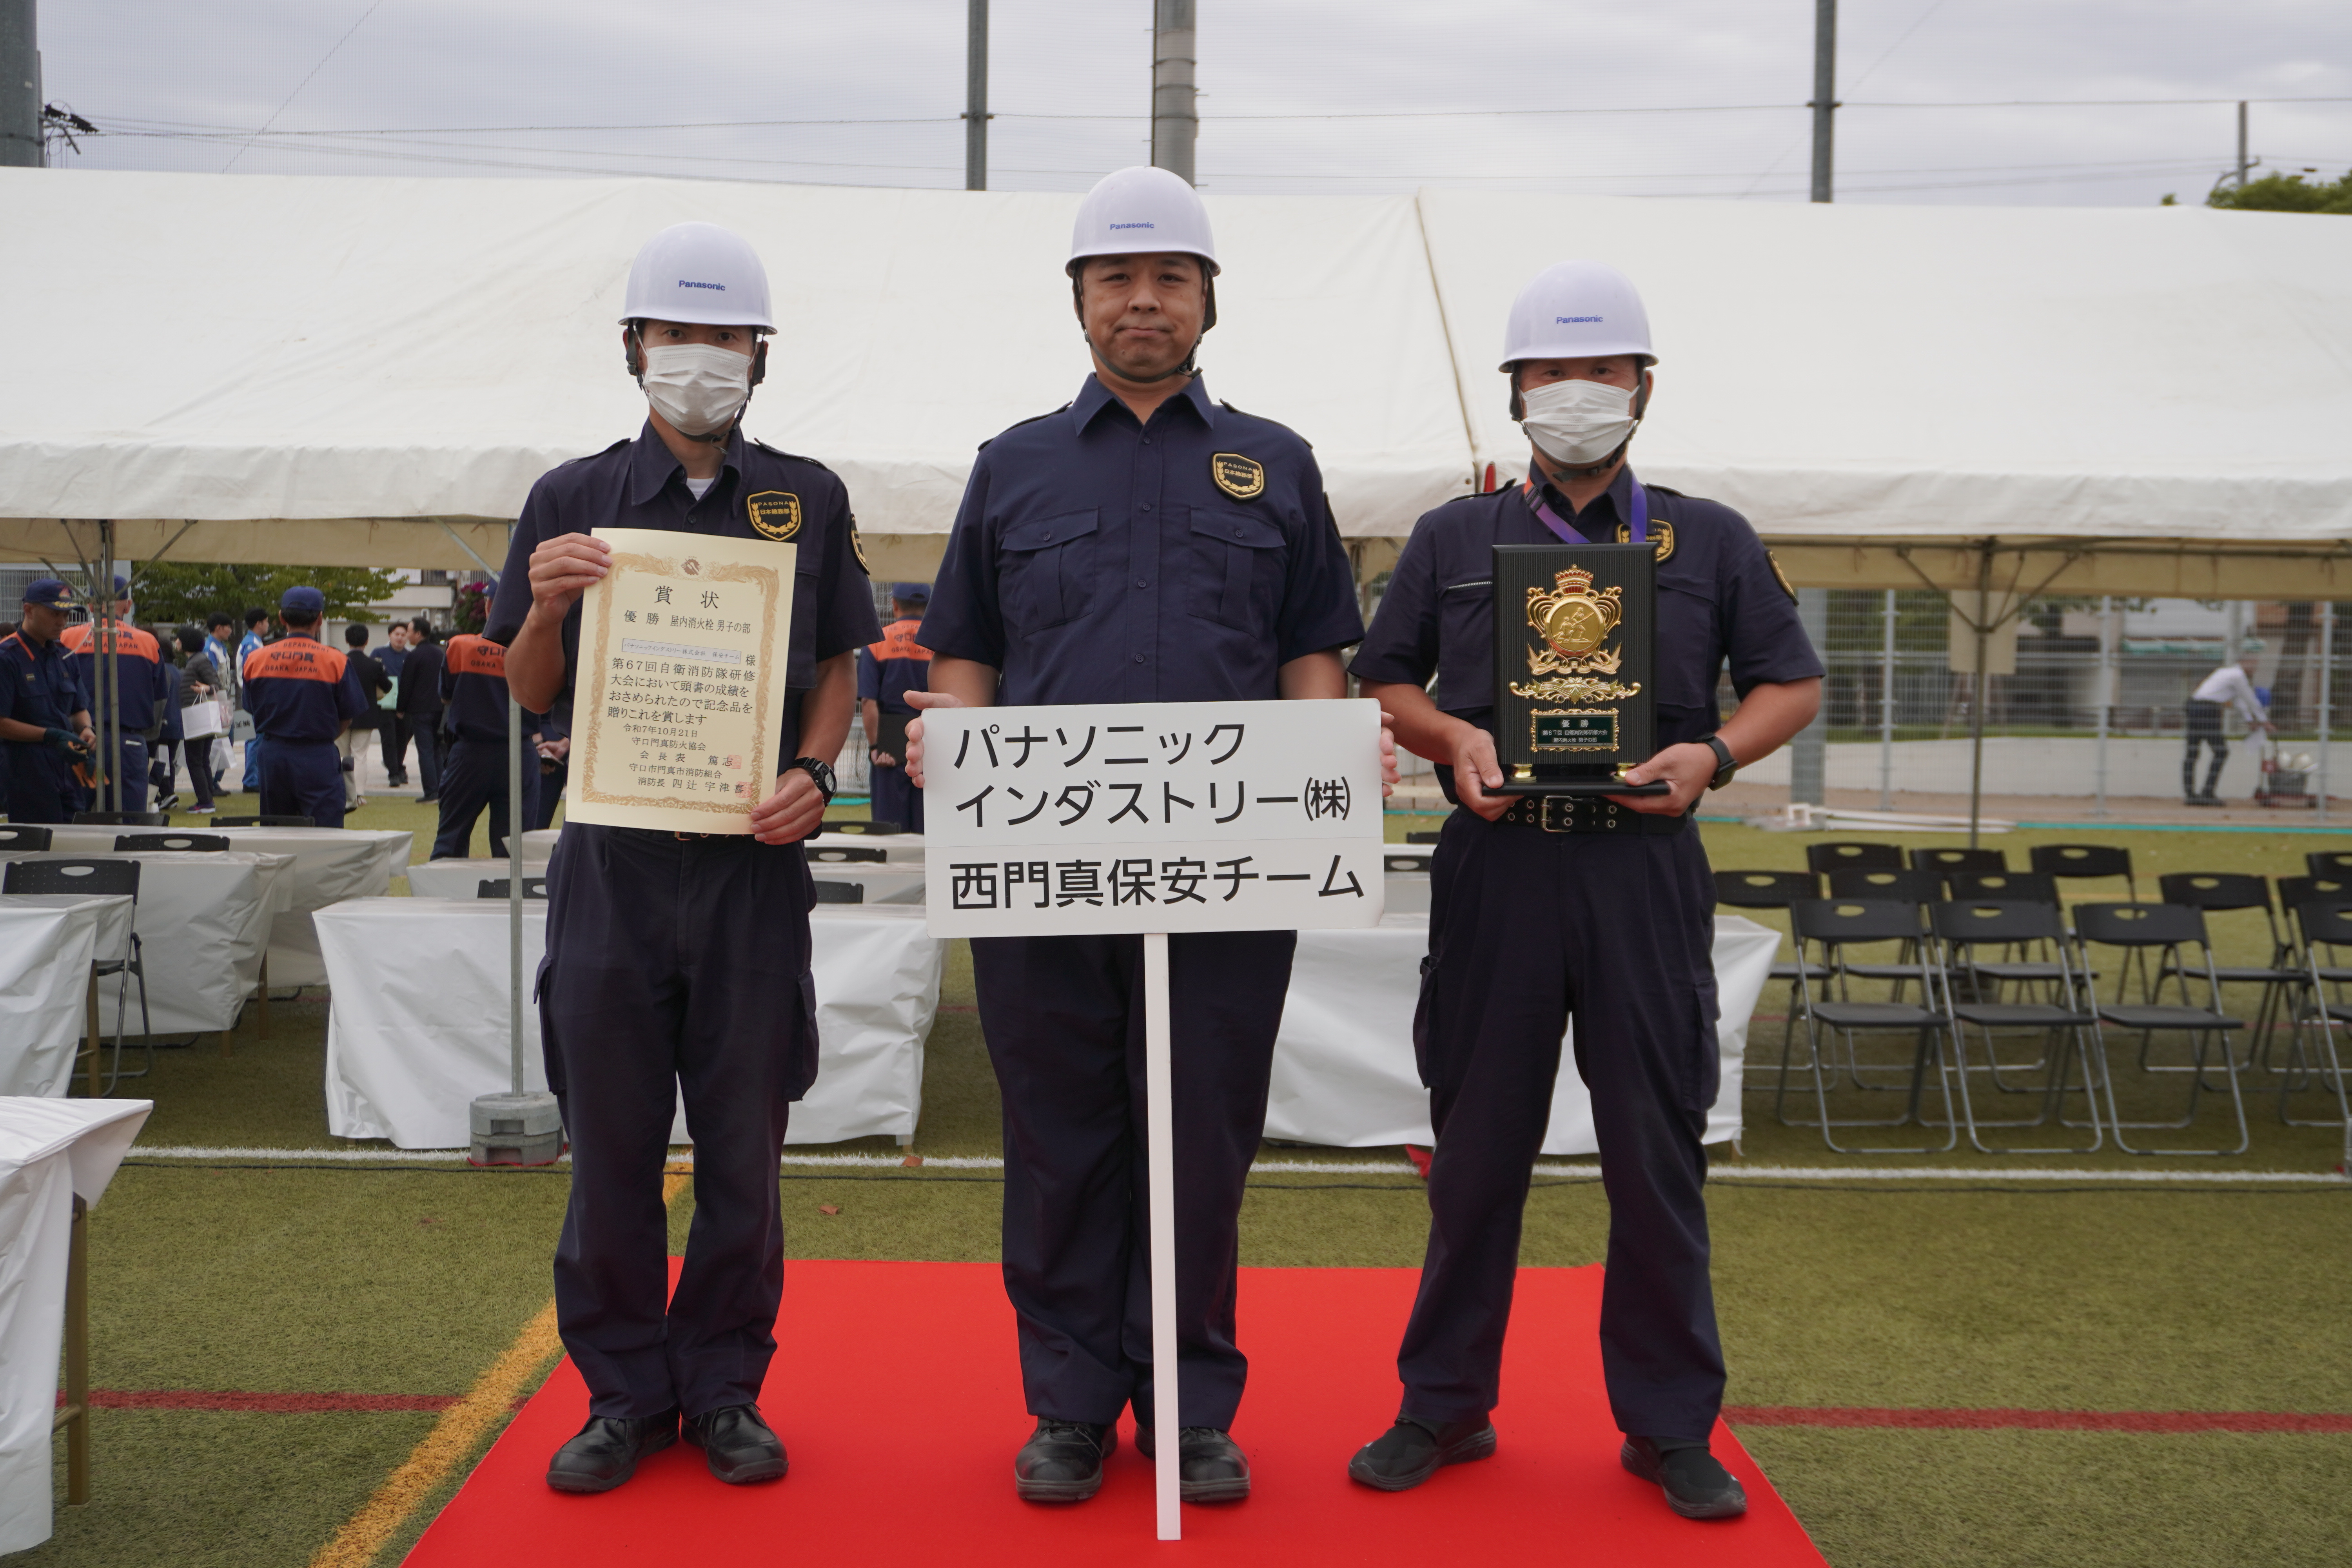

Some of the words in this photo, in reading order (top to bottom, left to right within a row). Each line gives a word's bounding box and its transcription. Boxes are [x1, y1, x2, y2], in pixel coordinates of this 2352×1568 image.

[679, 280, 725, 291] Panasonic
[1556, 315, 1603, 324] Panasonic
[1223, 462, 1252, 471] PASONA
[746, 654, 756, 666] 様
[610, 674, 749, 697] 大会において頭書の成績を
[609, 690, 753, 713] おさめられたので記念品を
[608, 706, 707, 725] 贈りこれを賞します
[623, 723, 697, 737] 令和7年10月21日
[632, 737, 706, 751] 守口門真防火協会
[954, 724, 1245, 769] パナソニック
[629, 763, 722, 779] 守口市門真市消防組合
[949, 855, 1365, 910] 西門真保安チーム
